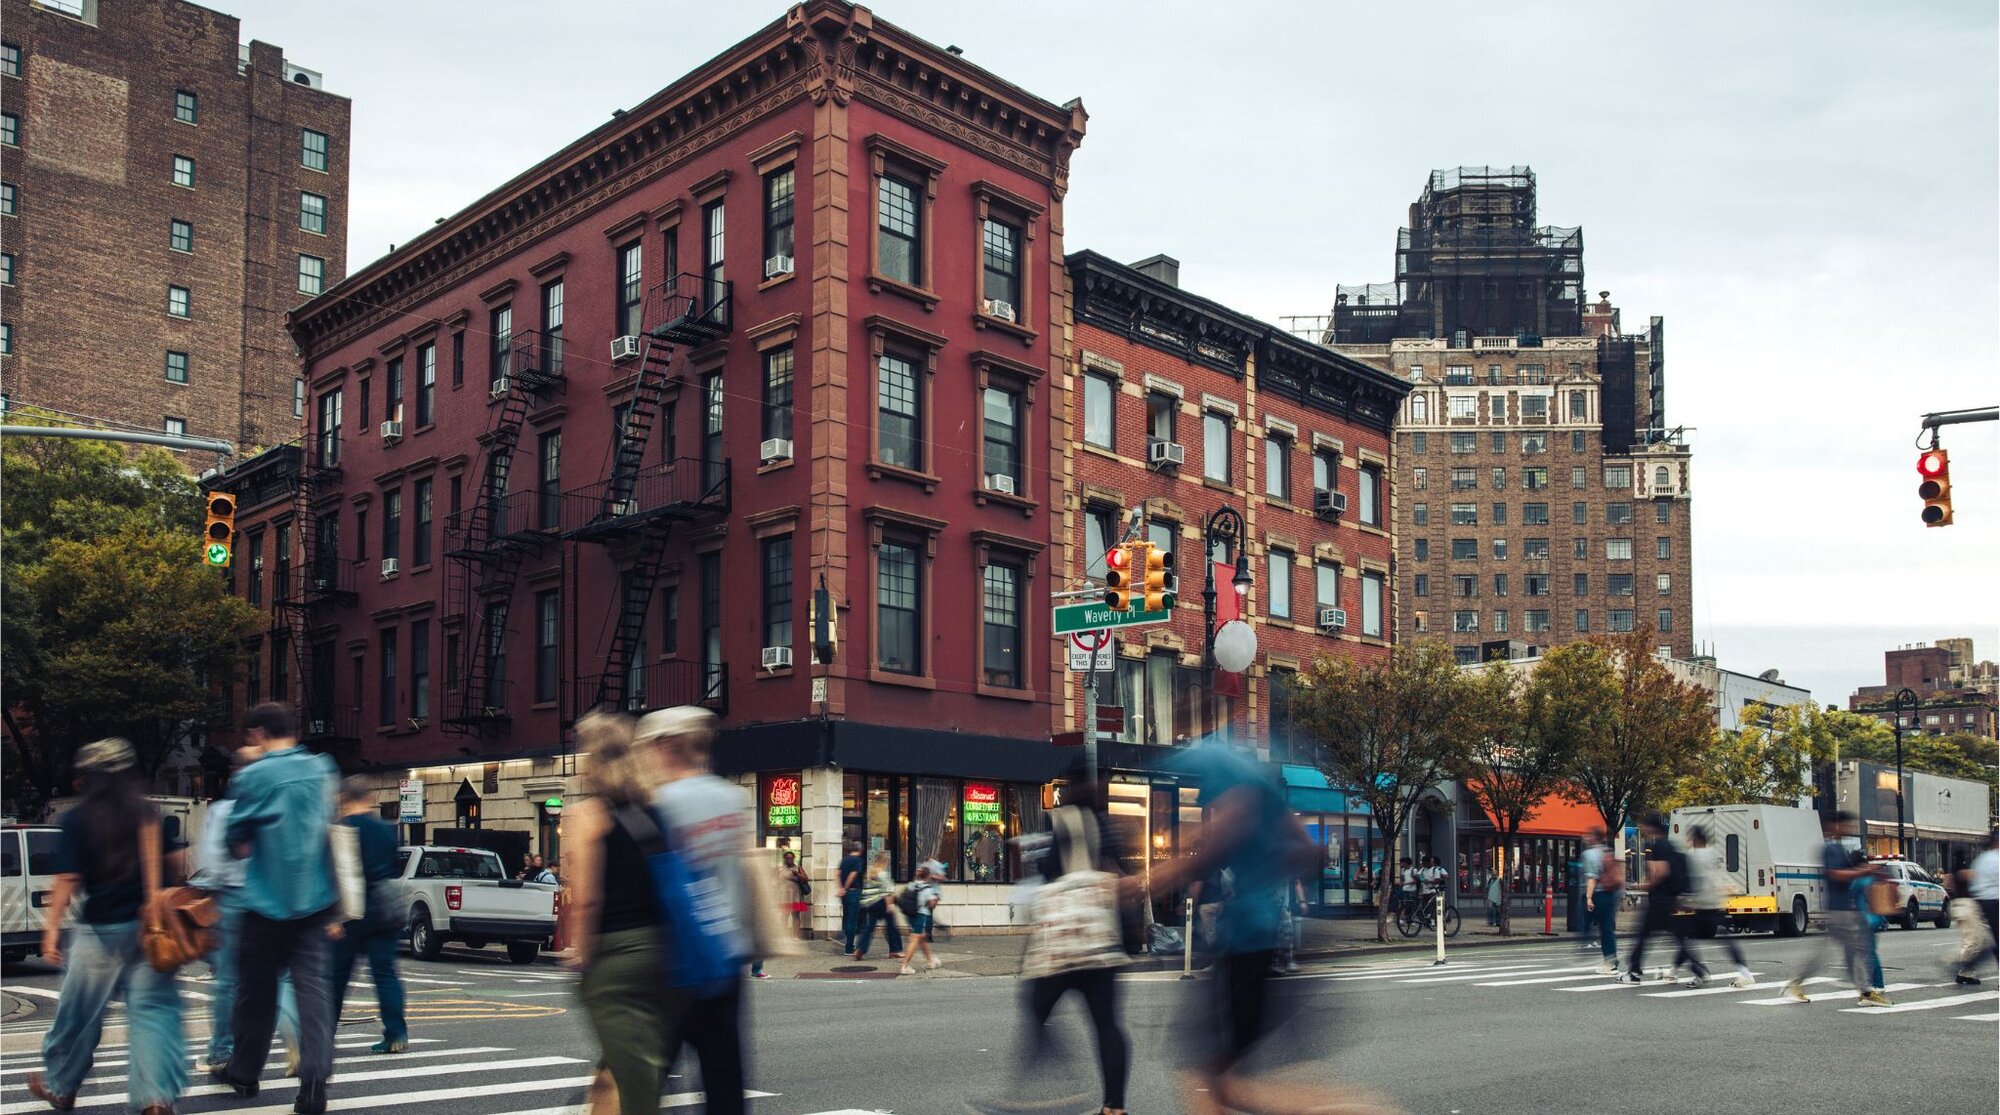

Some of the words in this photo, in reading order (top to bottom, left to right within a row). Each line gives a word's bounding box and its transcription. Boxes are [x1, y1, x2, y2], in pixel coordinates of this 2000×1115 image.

[1084, 609, 1122, 623] Waverly
[1126, 604, 1135, 618] Pl
[965, 801, 988, 811] CORNED
[988, 802, 1000, 811] BEEF
[769, 815, 785, 825] SPARE
[785, 815, 797, 825] RIBS
[972, 812, 999, 822] PASTRAMI
